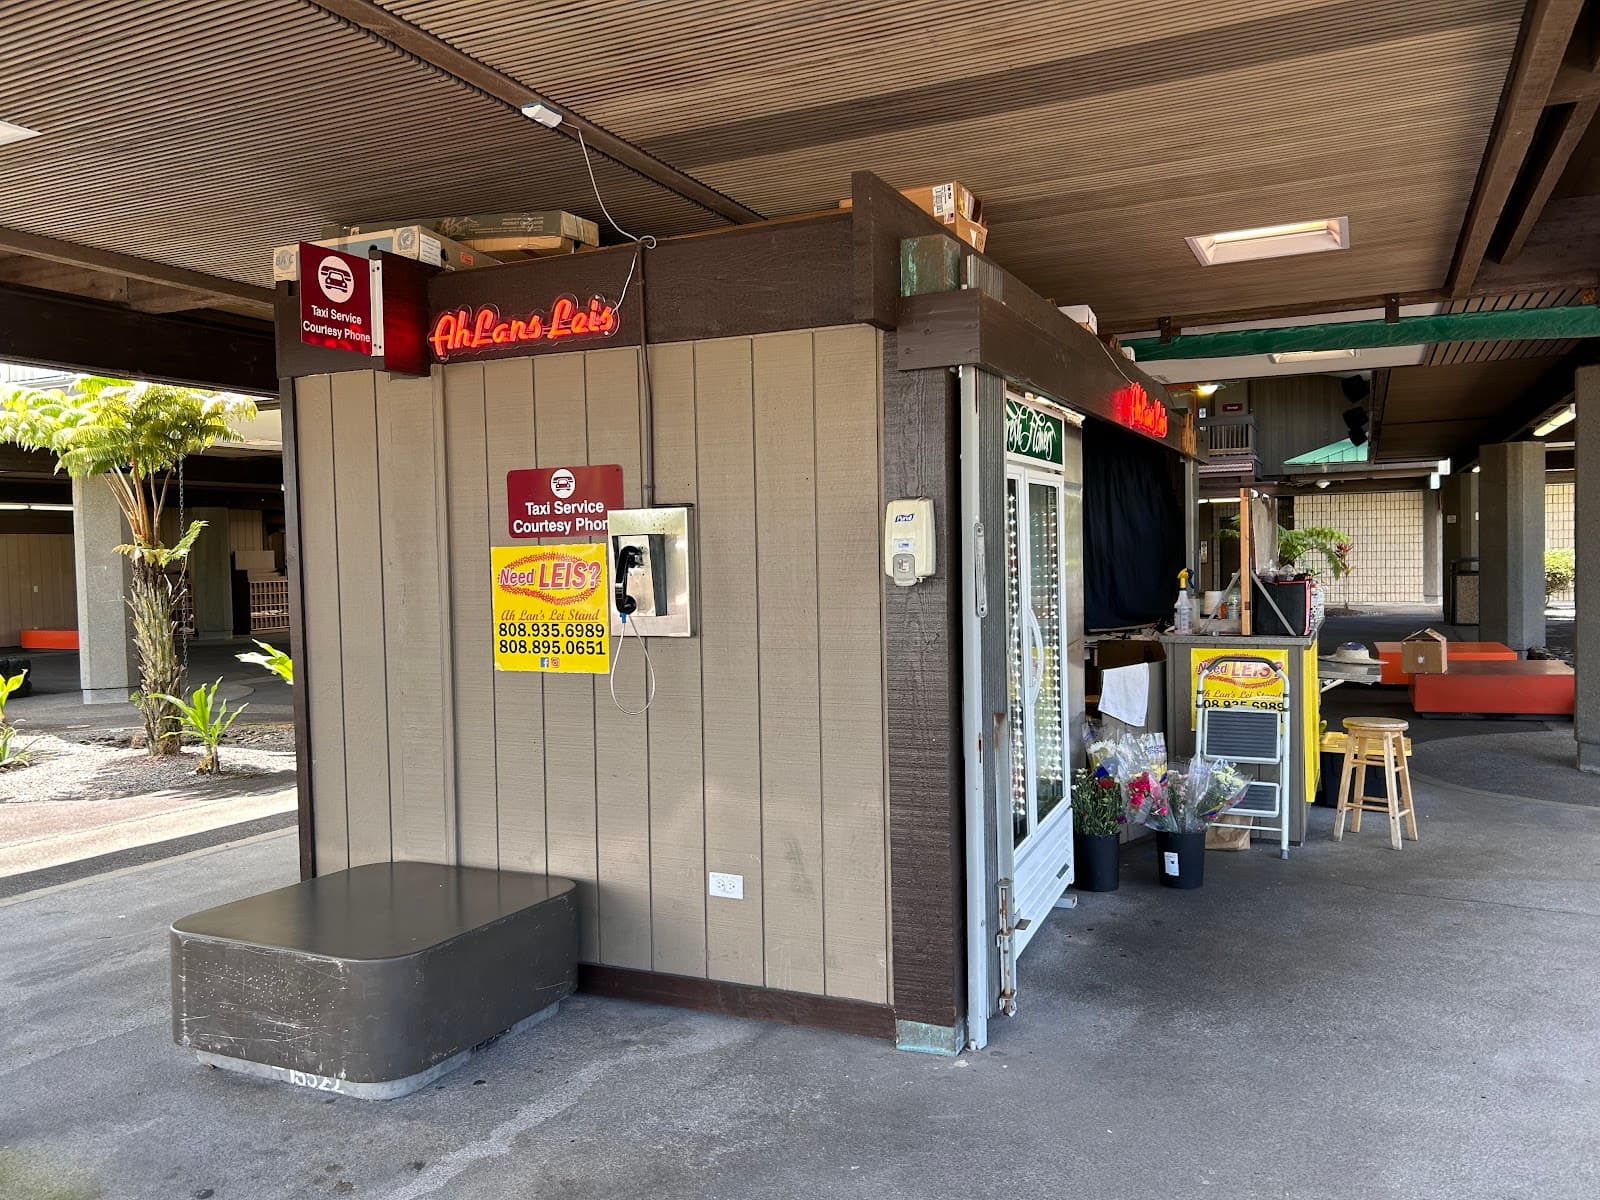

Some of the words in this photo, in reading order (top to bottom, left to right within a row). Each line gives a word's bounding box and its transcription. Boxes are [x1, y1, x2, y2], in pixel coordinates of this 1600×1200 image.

[311, 304, 329, 318] Taxi
[330, 308, 362, 325] Service
[302, 320, 342, 340] Courtesy
[344, 328, 371, 342] Phone
[429, 309, 474, 356] Ah
[546, 298, 613, 339] Leis
[525, 501, 550, 516] Taxi
[554, 499, 604, 515] Service
[513, 519, 571, 535] Courtesy
[575, 517, 609, 532] Phon
[500, 567, 535, 585] Need
[538, 560, 602, 589] LEIS?
[501, 609, 516, 621] Ah
[519, 609, 545, 621] Lan's
[549, 608, 565, 621] Lei
[567, 608, 600, 621] Stand
[498, 622, 606, 638] 808.935.6989
[499, 639, 607, 656] 808.895.0651
